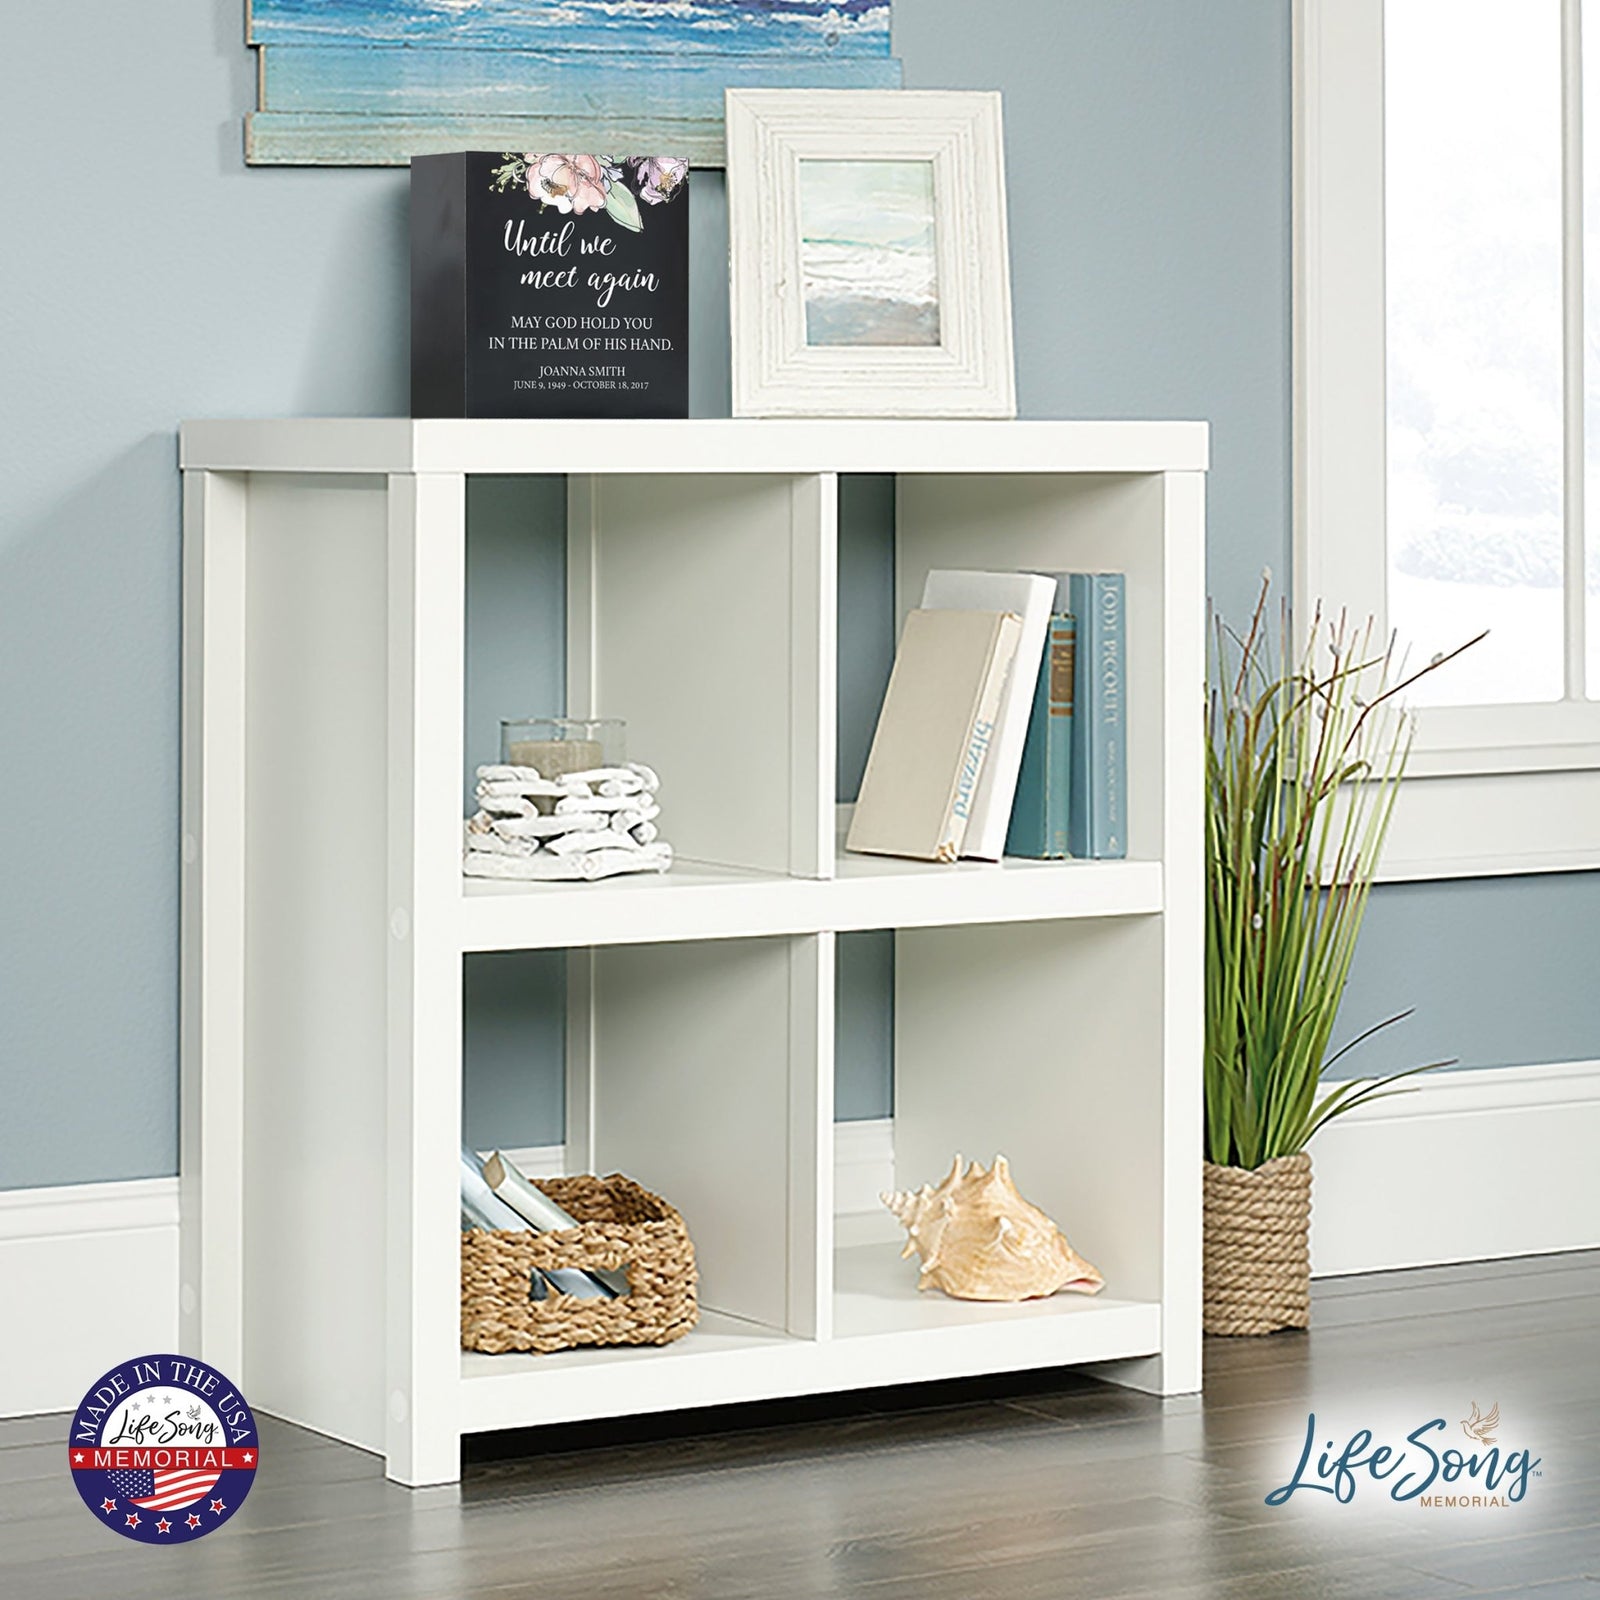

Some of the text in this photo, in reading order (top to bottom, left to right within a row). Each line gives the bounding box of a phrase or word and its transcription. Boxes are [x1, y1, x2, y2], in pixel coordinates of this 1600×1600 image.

[504, 219, 616, 257] Until we
[520, 266, 660, 308] meet again
[511, 315, 653, 330] MAY GOD HOLD YOU
[489, 336, 674, 351] IN THE PALM OF HIS HAND.
[513, 380, 537, 390] JUNE
[538, 381, 546, 391] 9,
[547, 381, 567, 390] 1949
[572, 380, 617, 390] OCTOBER
[618, 380, 630, 391] 18,
[630, 381, 650, 390] 2017
[538, 365, 626, 379] JOANNA SMITH
[1100, 583, 1118, 632] JODI
[1102, 640, 1118, 726] PICOULT
[952, 718, 995, 819] blizzard
